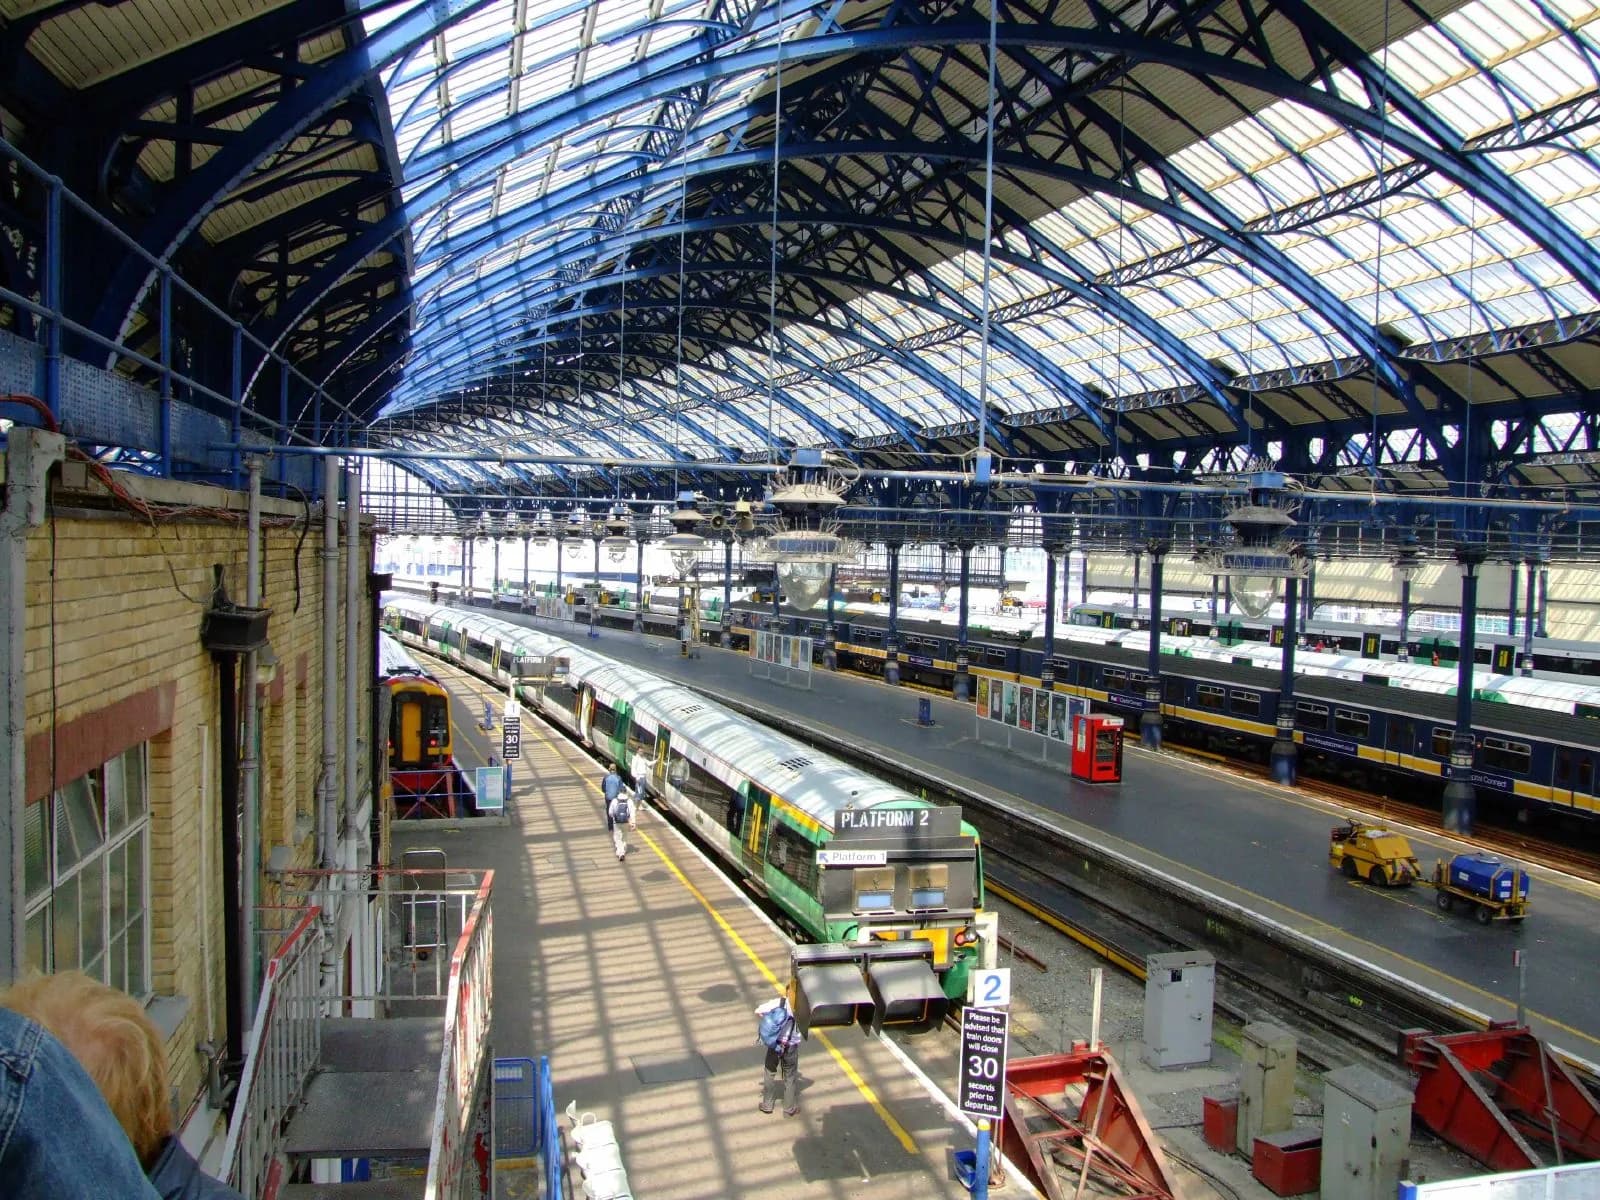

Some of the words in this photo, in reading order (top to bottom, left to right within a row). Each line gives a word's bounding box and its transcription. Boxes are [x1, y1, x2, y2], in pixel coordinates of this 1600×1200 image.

[505, 735, 518, 744] 30
[1483, 775, 1507, 788] Connect
[841, 810, 914, 828] PLATFORM
[919, 809, 929, 826] 2
[832, 852, 876, 862] Platform
[983, 974, 1001, 1002] 2
[969, 1013, 990, 1023] Please
[991, 1015, 1000, 1024] be
[964, 1023, 989, 1032] advised
[991, 1025, 1004, 1034] that
[966, 1032, 981, 1041] train
[982, 1034, 1002, 1044] doors
[968, 1042, 980, 1051] will
[981, 1043, 998, 1053] close
[968, 1055, 998, 1079] 30
[968, 1081, 995, 1092] seconds
[969, 1091, 985, 1101] prior
[964, 1099, 998, 1112] departure
